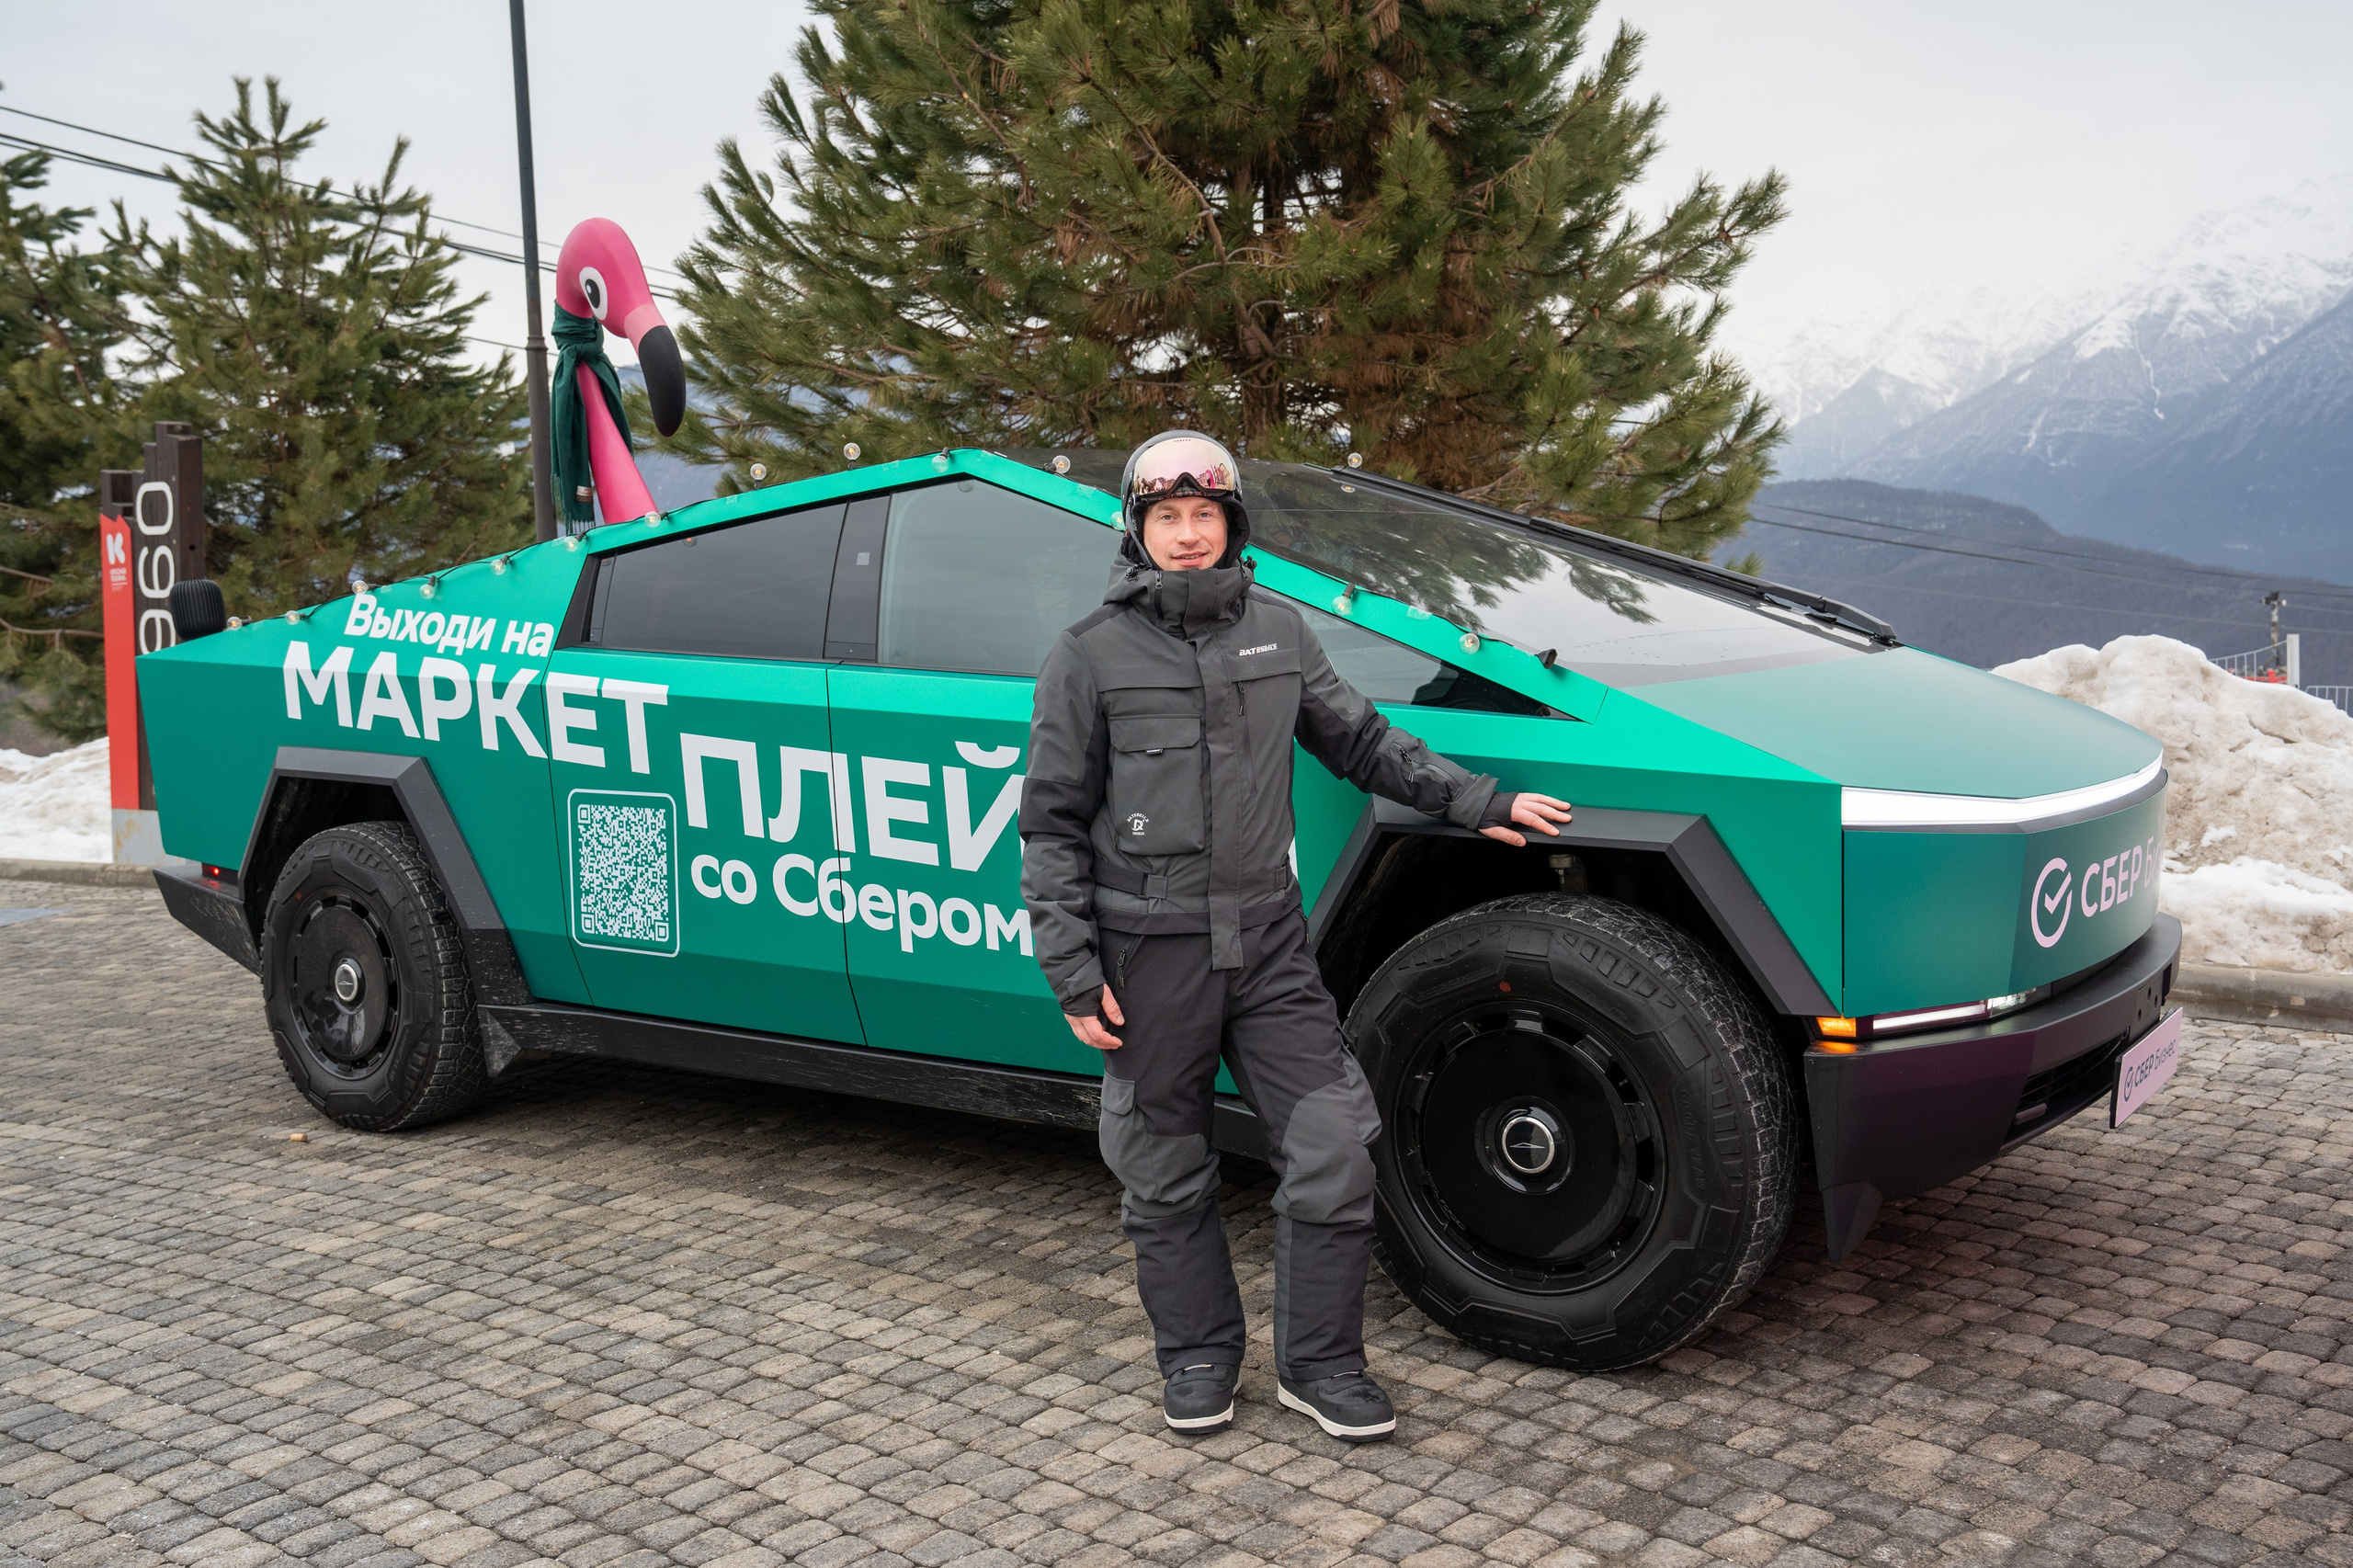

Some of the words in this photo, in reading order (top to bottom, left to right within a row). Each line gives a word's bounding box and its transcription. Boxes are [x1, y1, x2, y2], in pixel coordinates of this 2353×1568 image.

[344, 593, 498, 656] Выходи
[500, 619, 555, 658] на
[282, 641, 669, 775] МАРКЕТ
[690, 854, 757, 904] со
[772, 853, 1035, 957] Сбером
[2080, 845, 2143, 918] СБЕР
[2134, 1053, 2154, 1087] СБЕР
[2154, 1039, 2177, 1071] Бизнес
